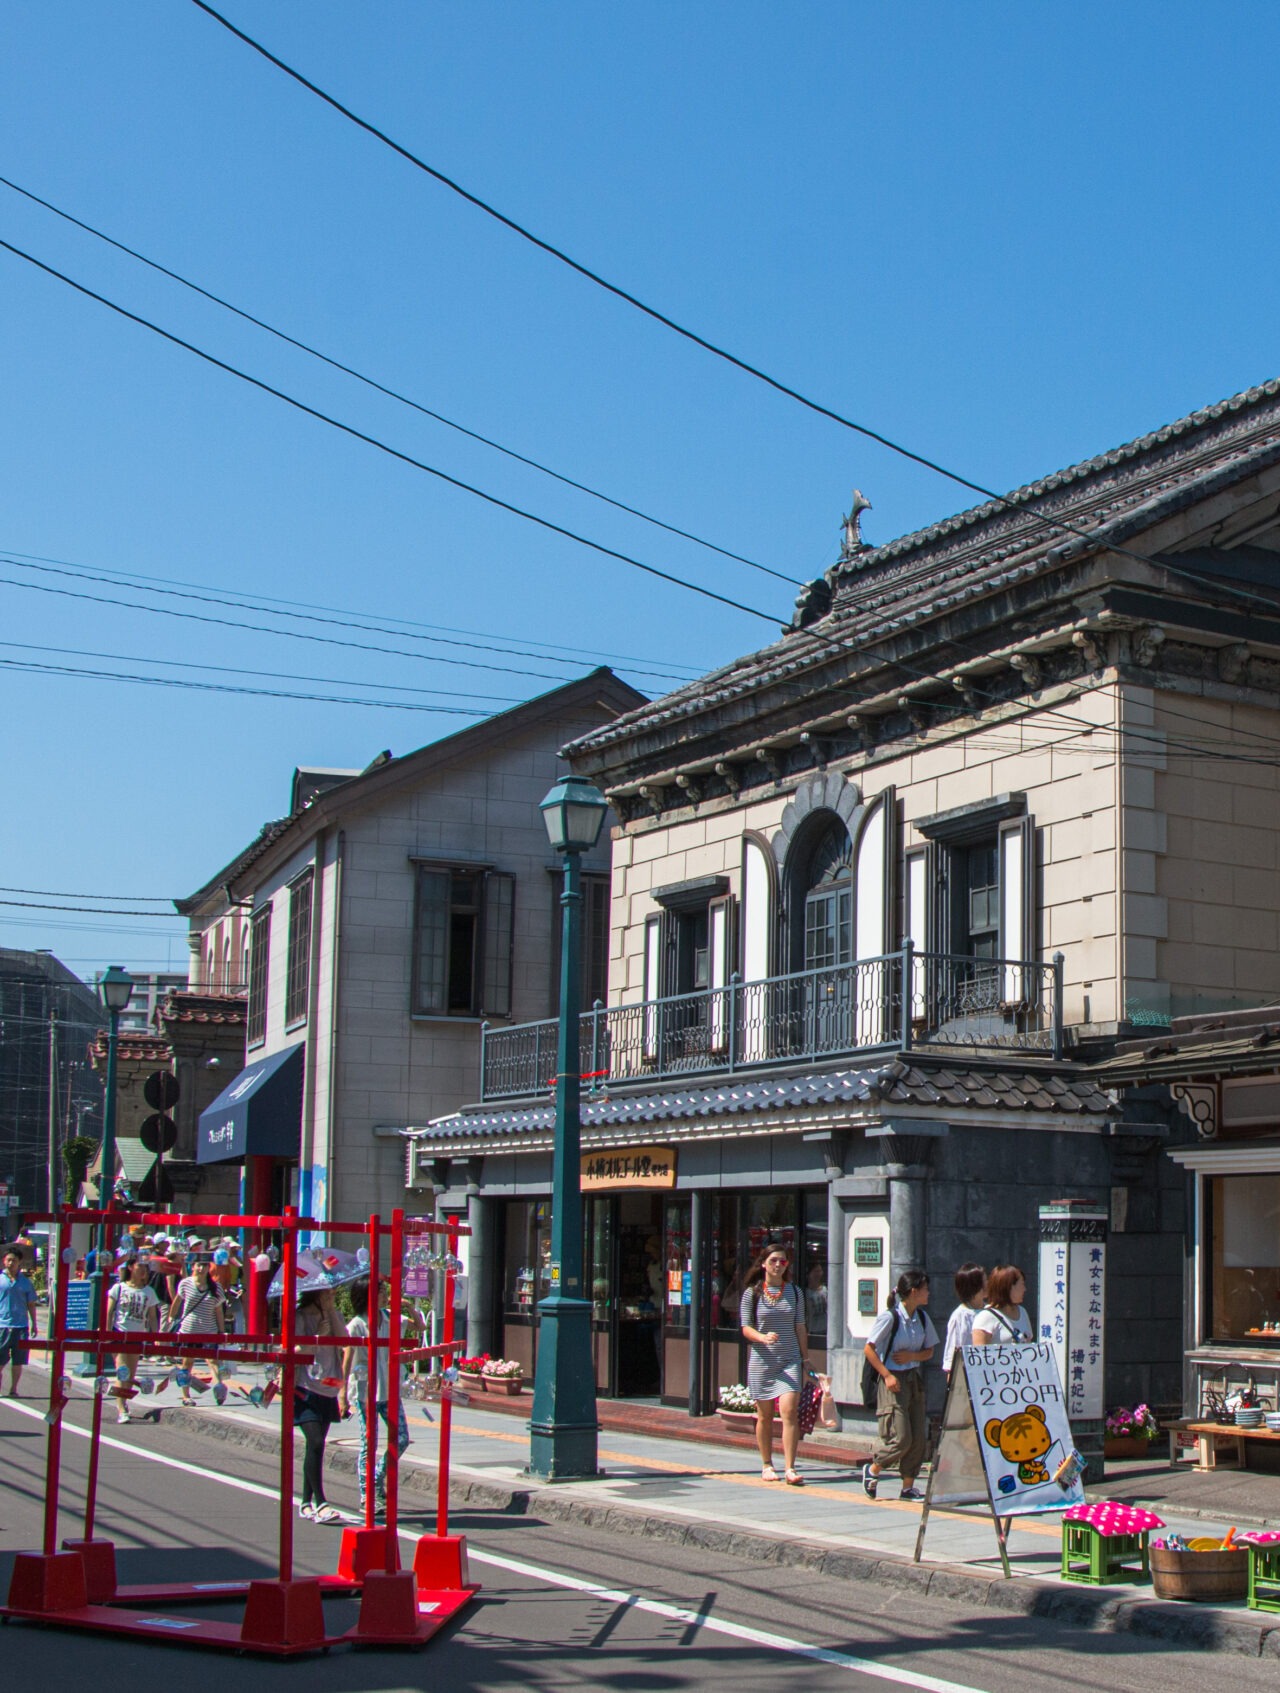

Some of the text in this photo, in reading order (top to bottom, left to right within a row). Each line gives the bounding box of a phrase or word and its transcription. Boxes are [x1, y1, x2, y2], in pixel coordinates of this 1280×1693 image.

[1054, 1247, 1066, 1344] 七日食べたら
[1088, 1248, 1104, 1365] 貴女もなれます
[967, 1344, 1051, 1367] おもちゃつり
[983, 1366, 1040, 1386] いっかい
[979, 1384, 1060, 1406] 200円
